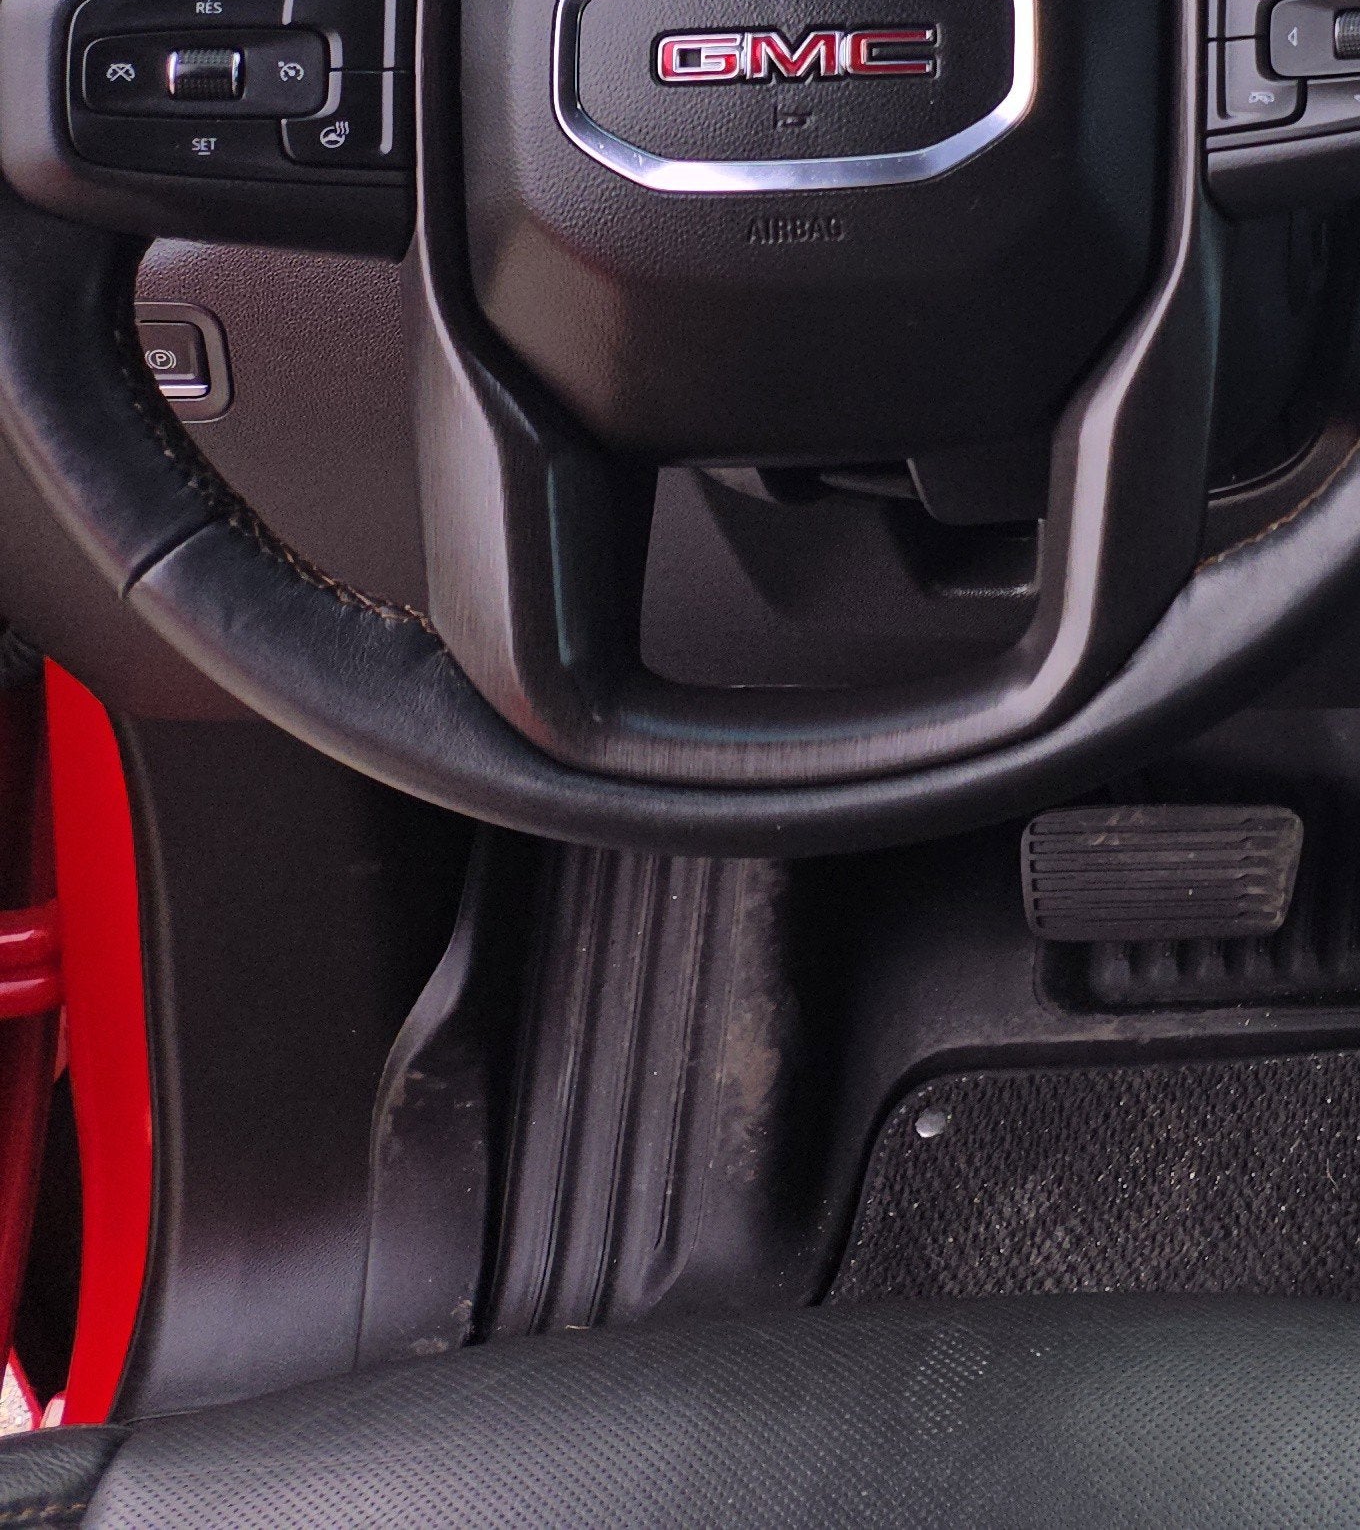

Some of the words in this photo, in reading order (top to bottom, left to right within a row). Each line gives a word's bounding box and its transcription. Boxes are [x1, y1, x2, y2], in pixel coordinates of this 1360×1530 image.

[195, 1, 223, 14] RES
[657, 28, 936, 82] GMC
[191, 137, 217, 151] SET
[748, 216, 846, 245] AIRBAG
